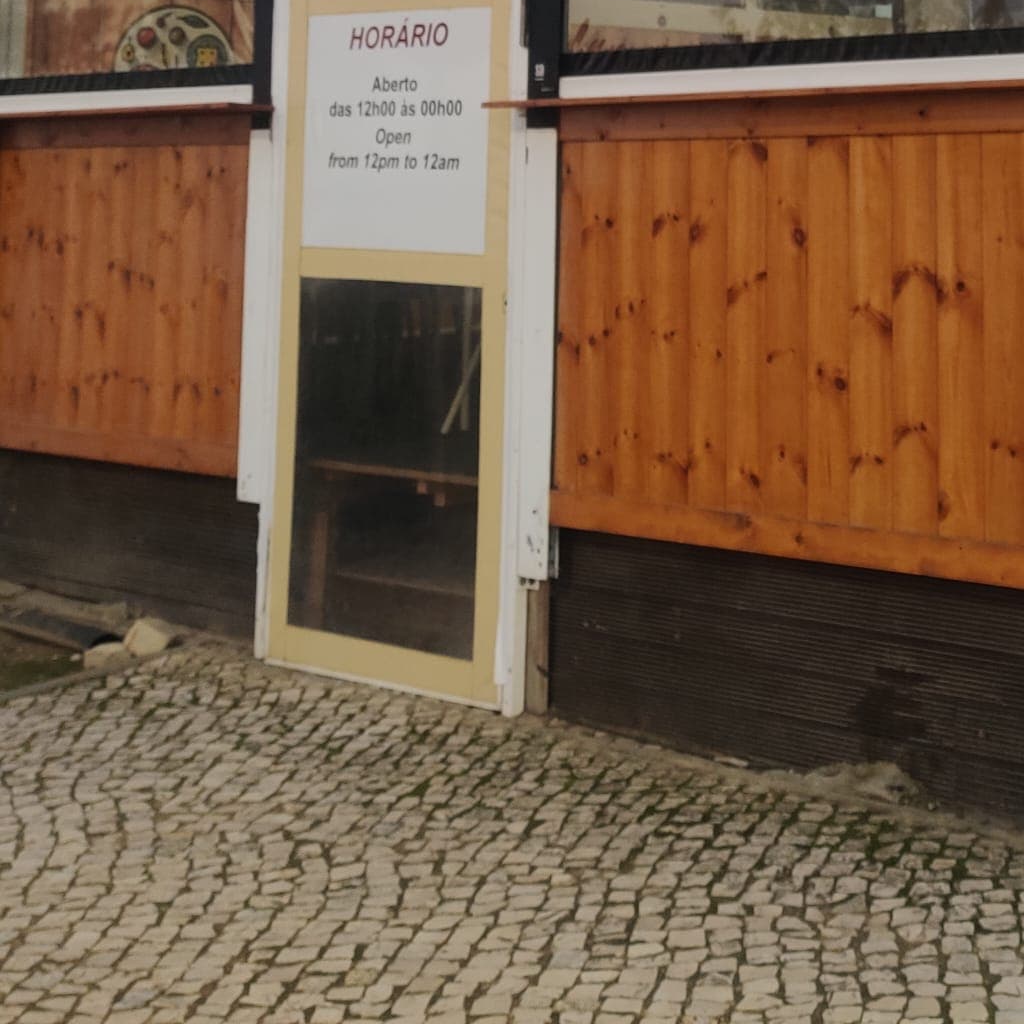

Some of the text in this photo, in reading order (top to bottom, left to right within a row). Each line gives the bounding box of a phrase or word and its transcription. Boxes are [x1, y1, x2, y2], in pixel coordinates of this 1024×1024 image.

[349, 17, 449, 51] HORÁRIO
[372, 76, 418, 92] Aberto
[329, 102, 352, 117] das
[358, 100, 396, 117] 12h00
[420, 99, 463, 117] 00h00
[375, 128, 412, 149] Open
[328, 152, 460, 173] from 12pm to 12am
